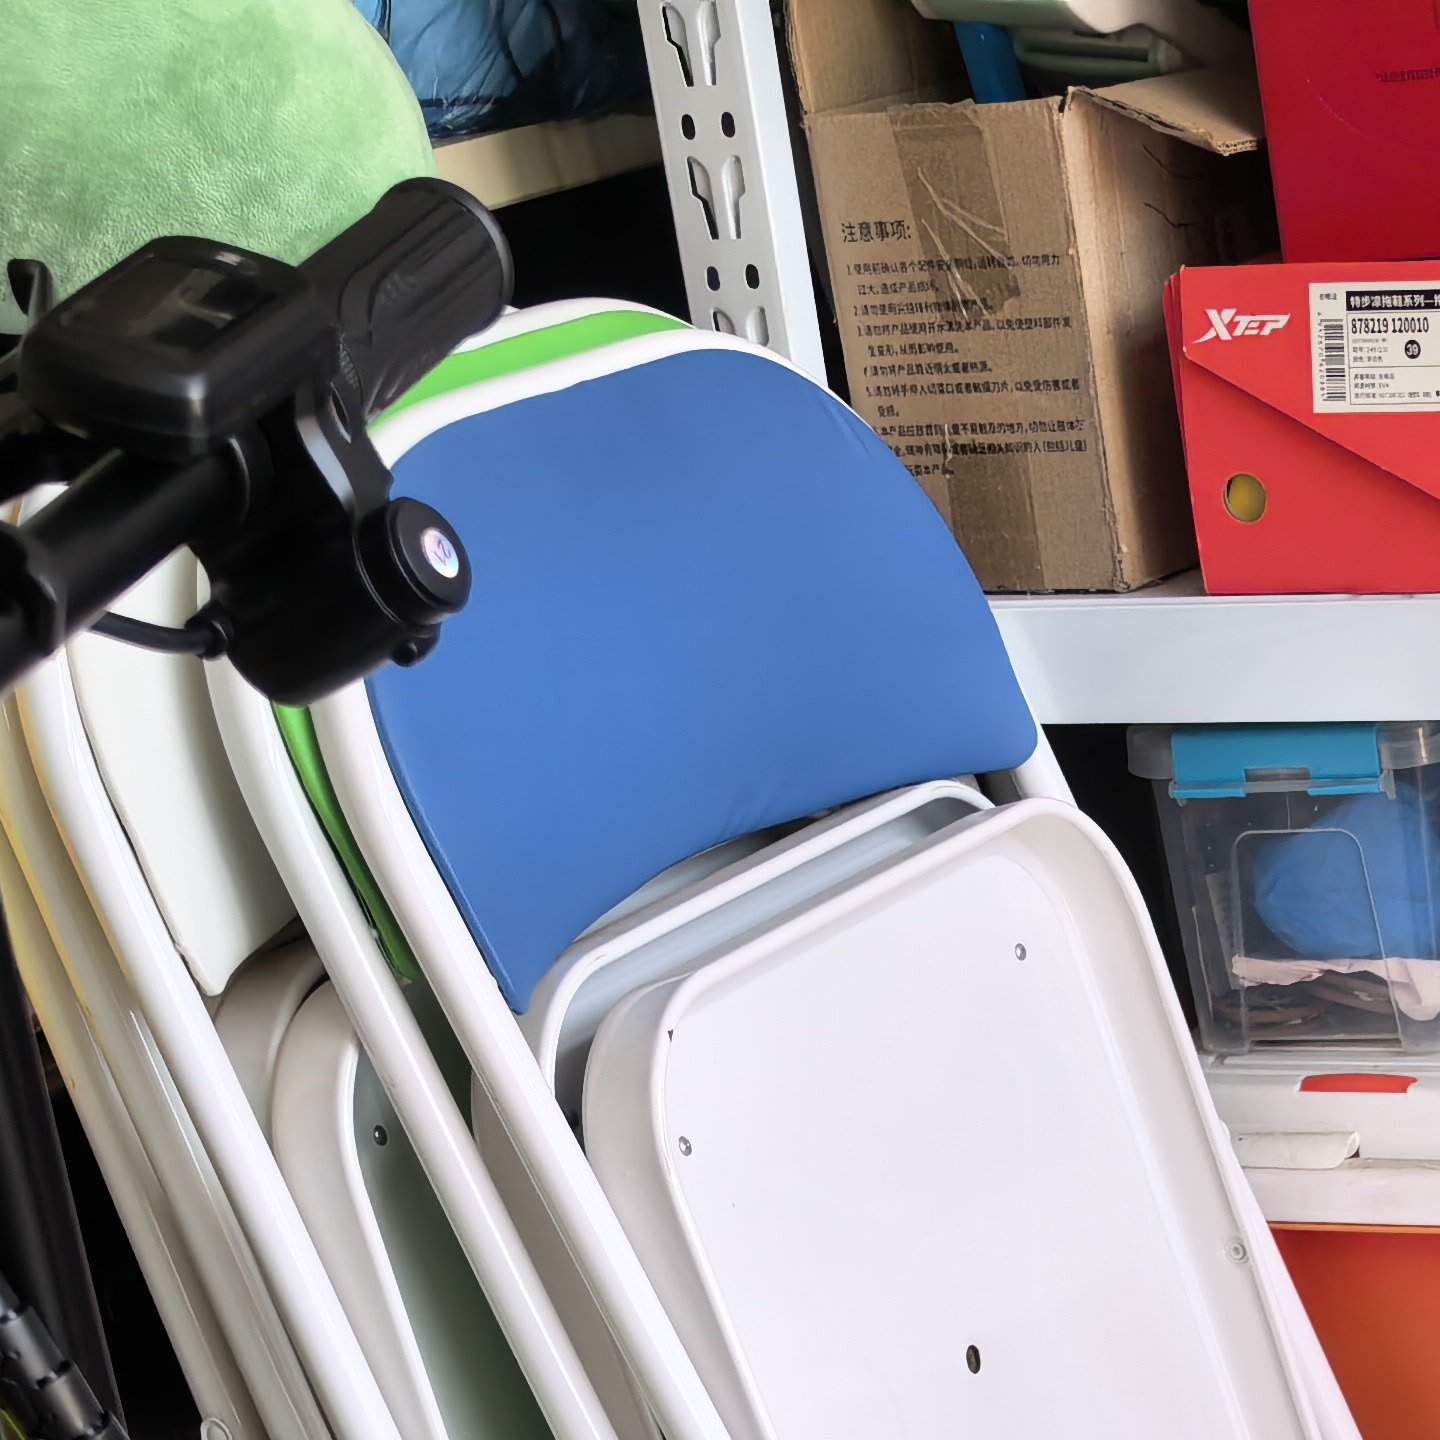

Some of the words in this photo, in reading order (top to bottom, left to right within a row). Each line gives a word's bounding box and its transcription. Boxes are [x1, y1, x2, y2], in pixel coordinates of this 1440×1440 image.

[1191, 308, 1291, 344] XTEP
[1351, 317, 1389, 335] 878219
[1390, 316, 1430, 334] 120010
[1405, 343, 1420, 357] 39
